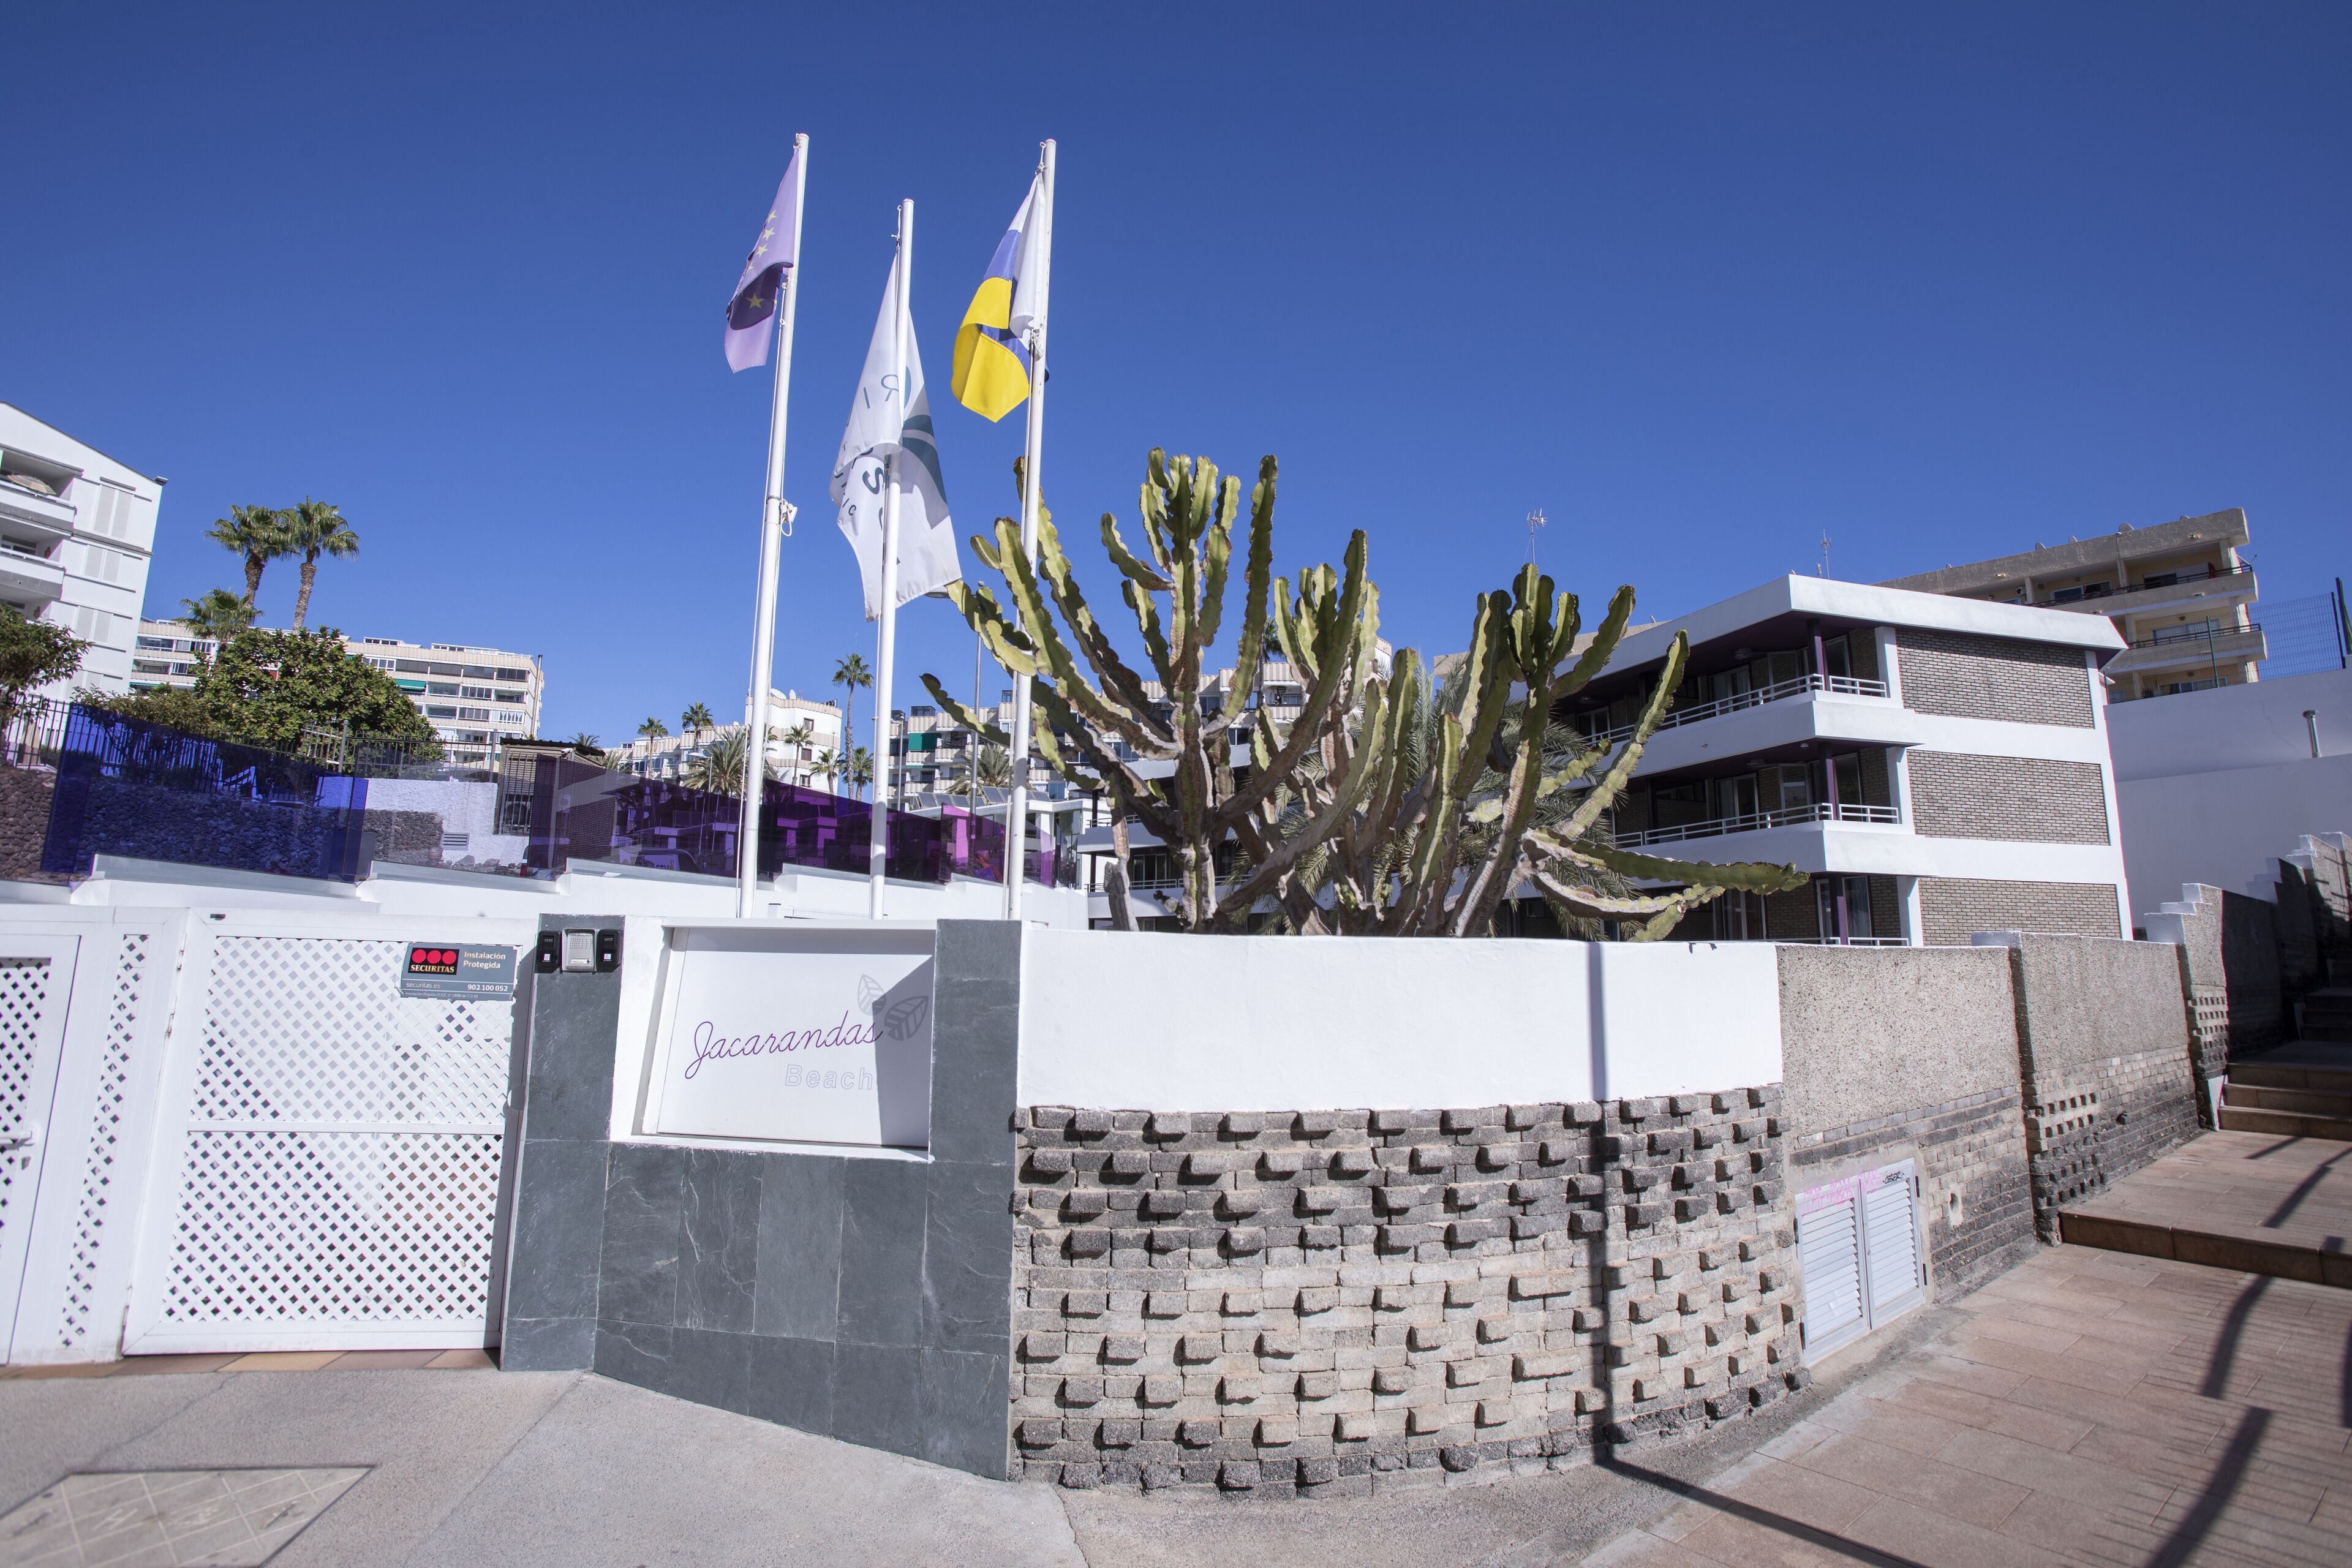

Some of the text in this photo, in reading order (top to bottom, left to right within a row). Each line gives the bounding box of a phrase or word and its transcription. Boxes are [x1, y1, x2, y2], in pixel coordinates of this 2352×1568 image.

[464, 951, 506, 960] Instalación
[410, 964, 455, 973] SECURITAS
[463, 960, 501, 970] Protegida
[684, 1010, 883, 1079] Jacarandas
[785, 1064, 873, 1090] Beach
